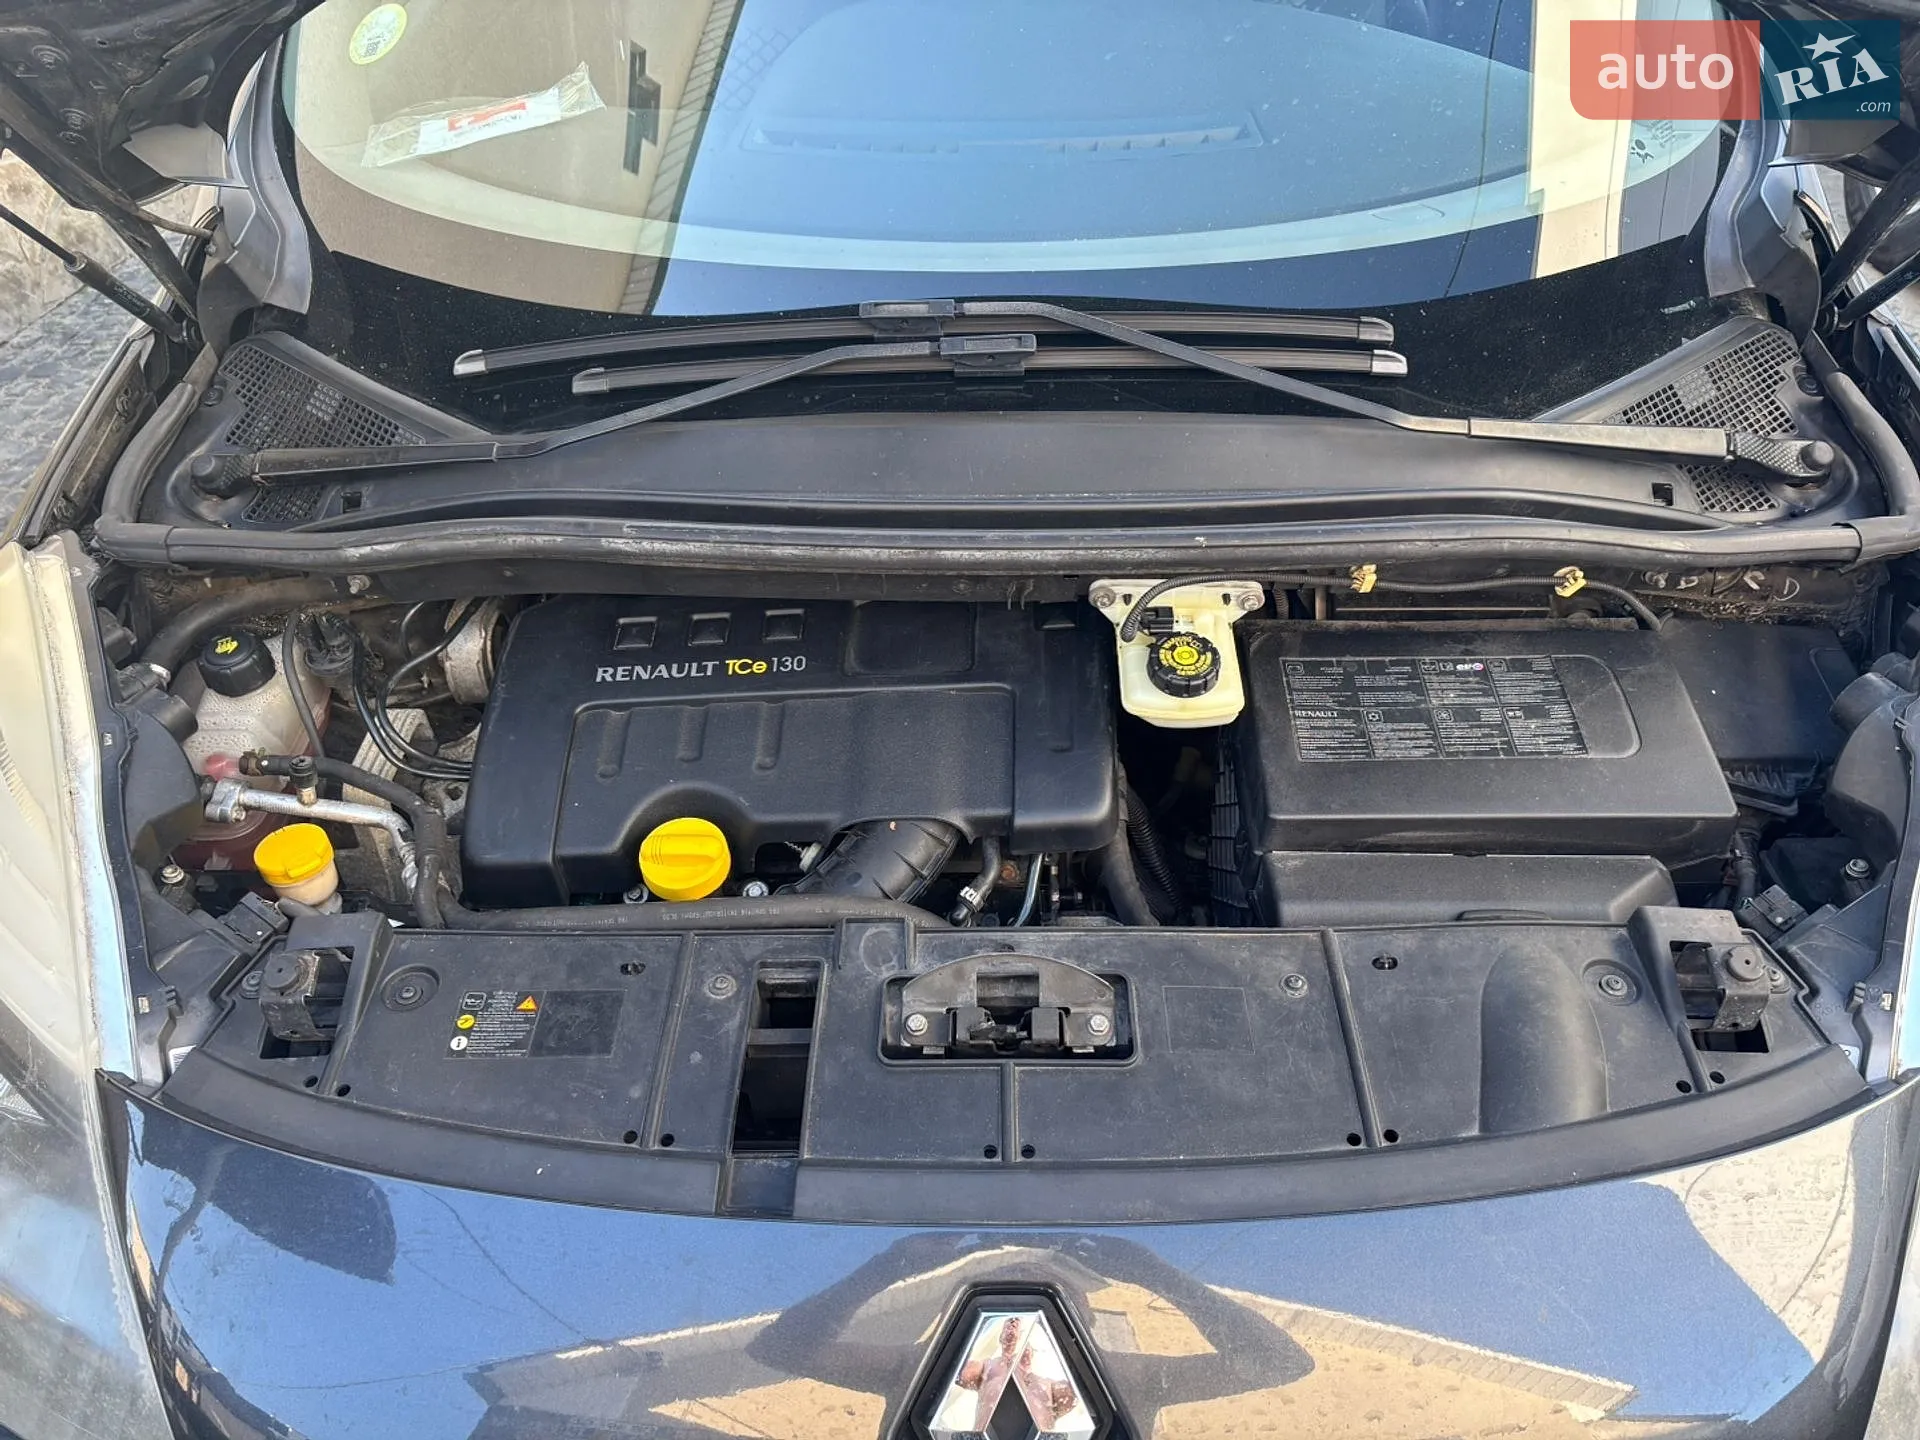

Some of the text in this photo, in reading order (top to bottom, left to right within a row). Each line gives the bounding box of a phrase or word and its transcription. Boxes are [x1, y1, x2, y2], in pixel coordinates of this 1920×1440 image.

[595, 656, 806, 682] RENAULT TCe 130
